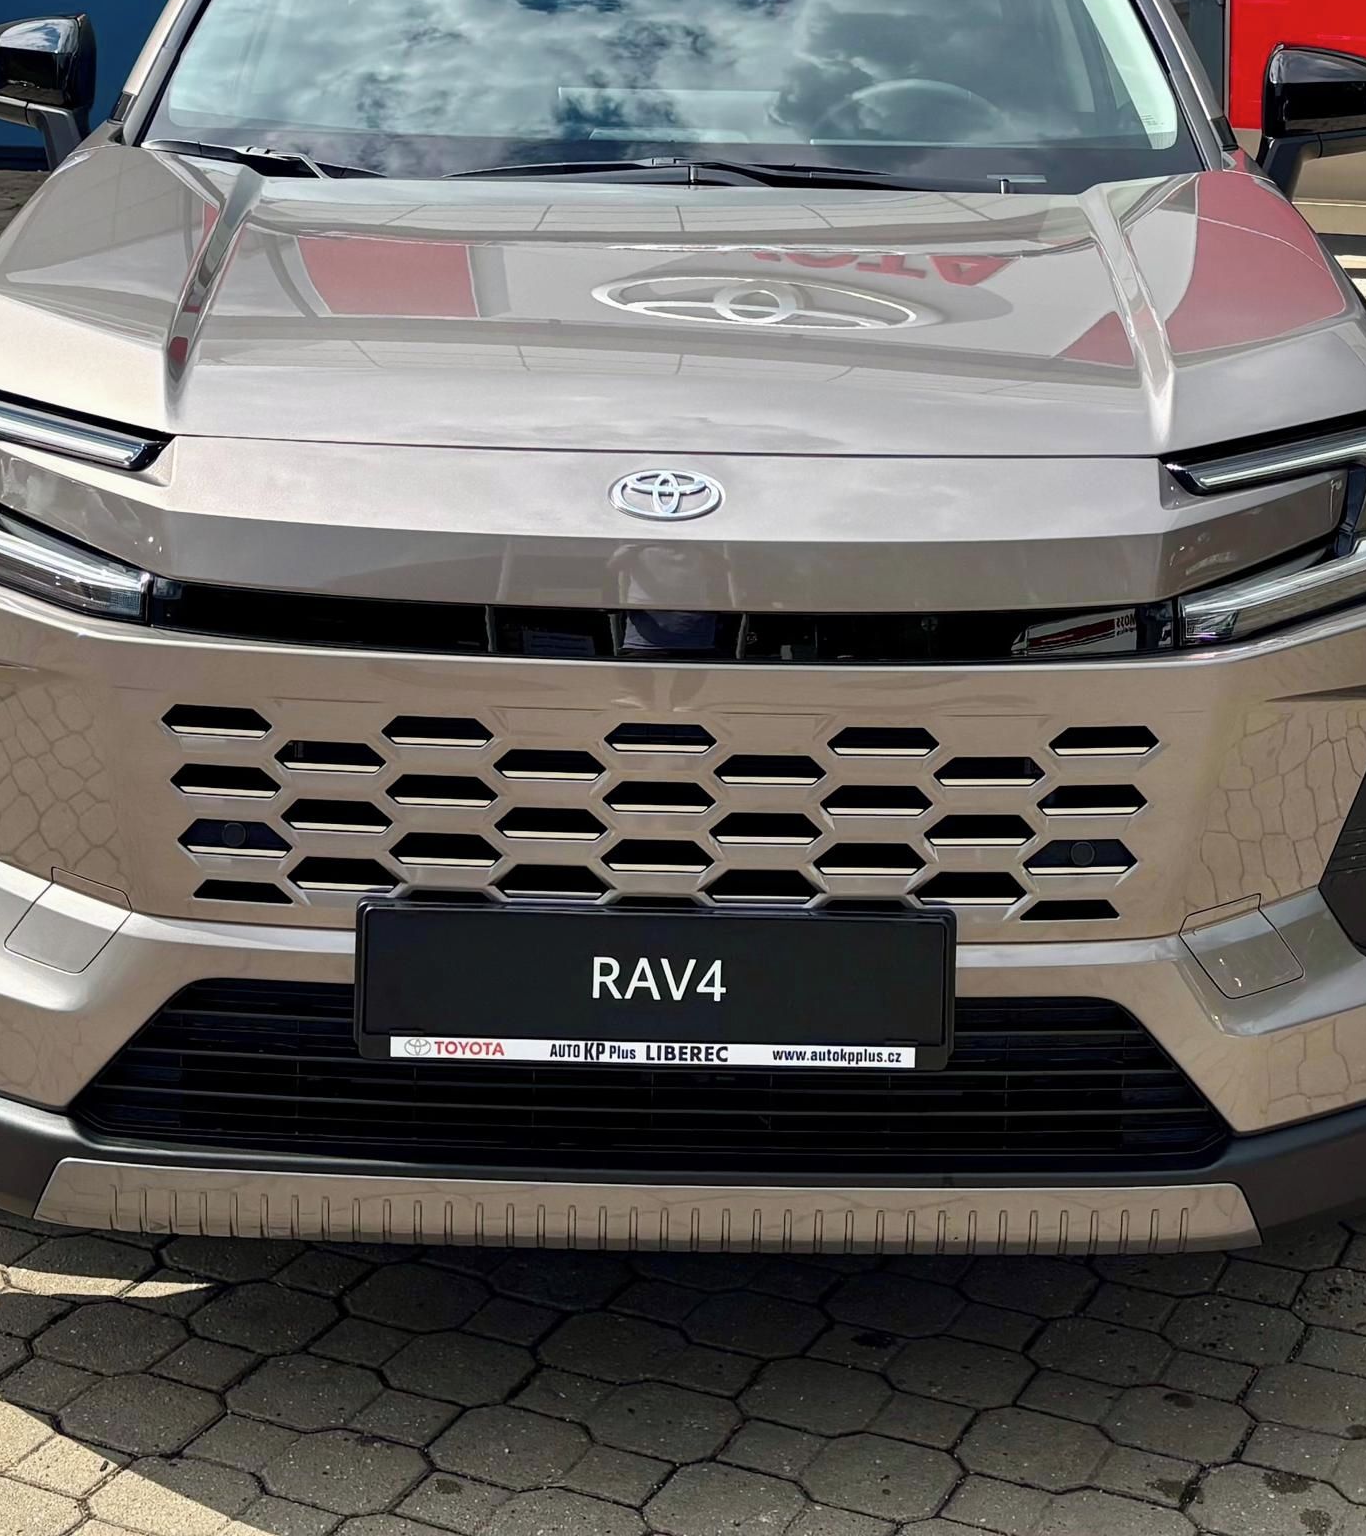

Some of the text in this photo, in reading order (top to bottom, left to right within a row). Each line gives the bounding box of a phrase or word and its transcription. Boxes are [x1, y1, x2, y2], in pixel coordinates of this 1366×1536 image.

[592, 956, 726, 1001] RAV4
[435, 1040, 902, 1065] TOYOTA AUTO KP Plus LIBEREC www.autokpplus.cz
